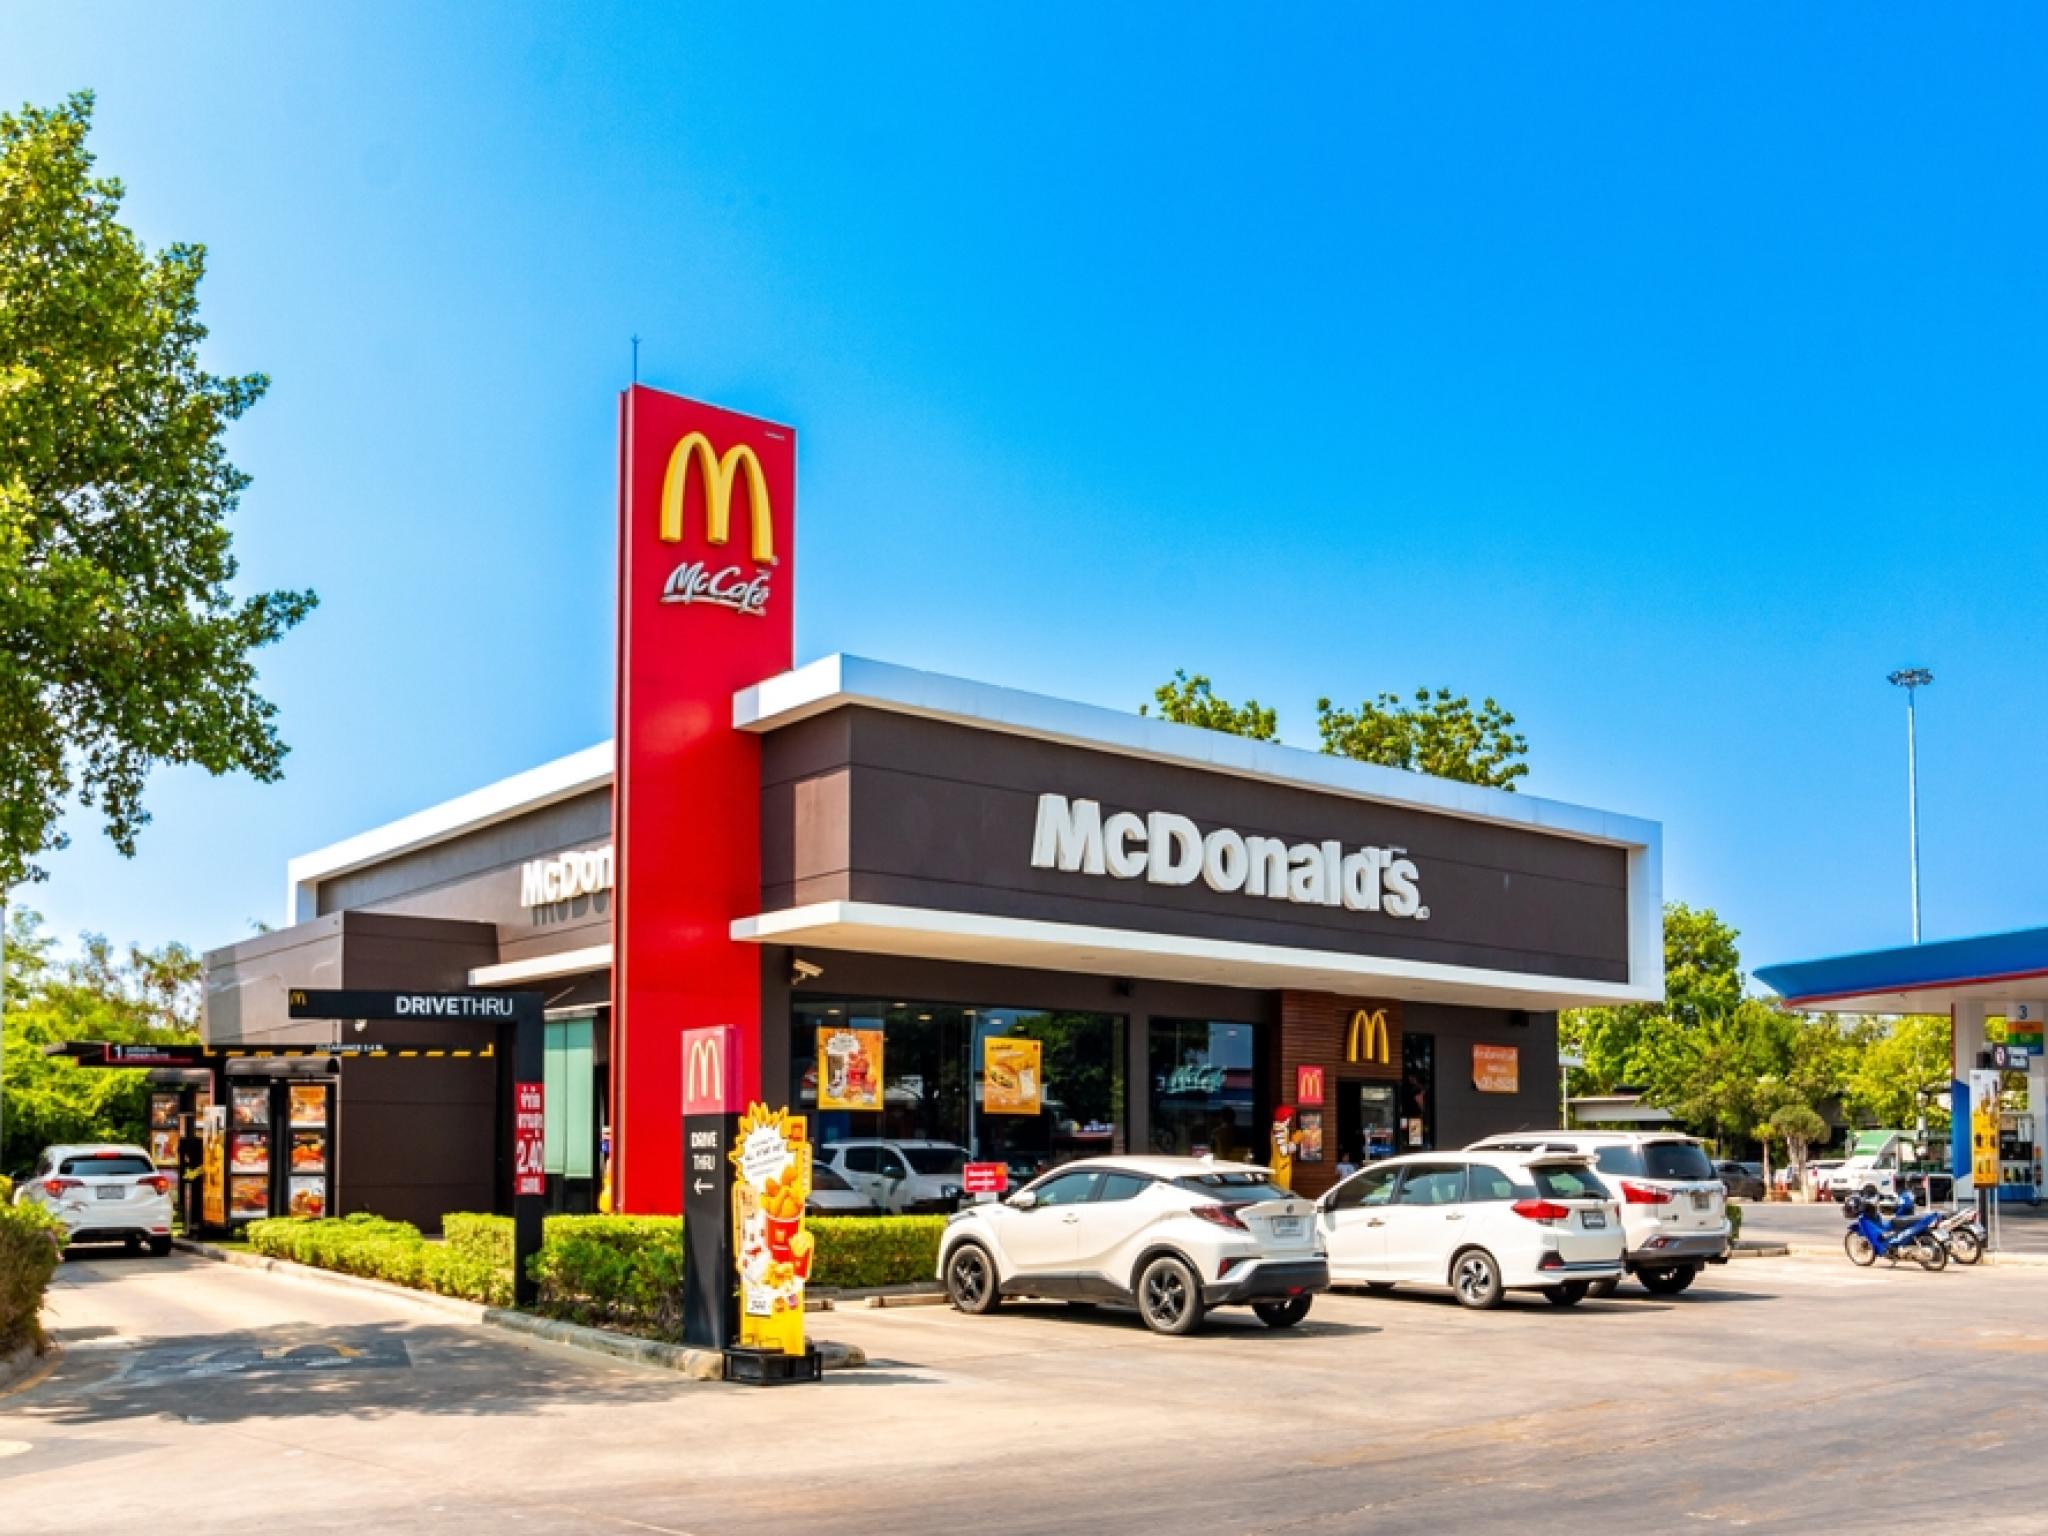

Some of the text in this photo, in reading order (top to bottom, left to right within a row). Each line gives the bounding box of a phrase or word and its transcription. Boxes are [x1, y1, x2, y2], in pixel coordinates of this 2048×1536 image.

[1031, 793, 1420, 918] McDonald's
[691, 1130, 718, 1149] DRIVE
[692, 1153, 716, 1171] THRU
